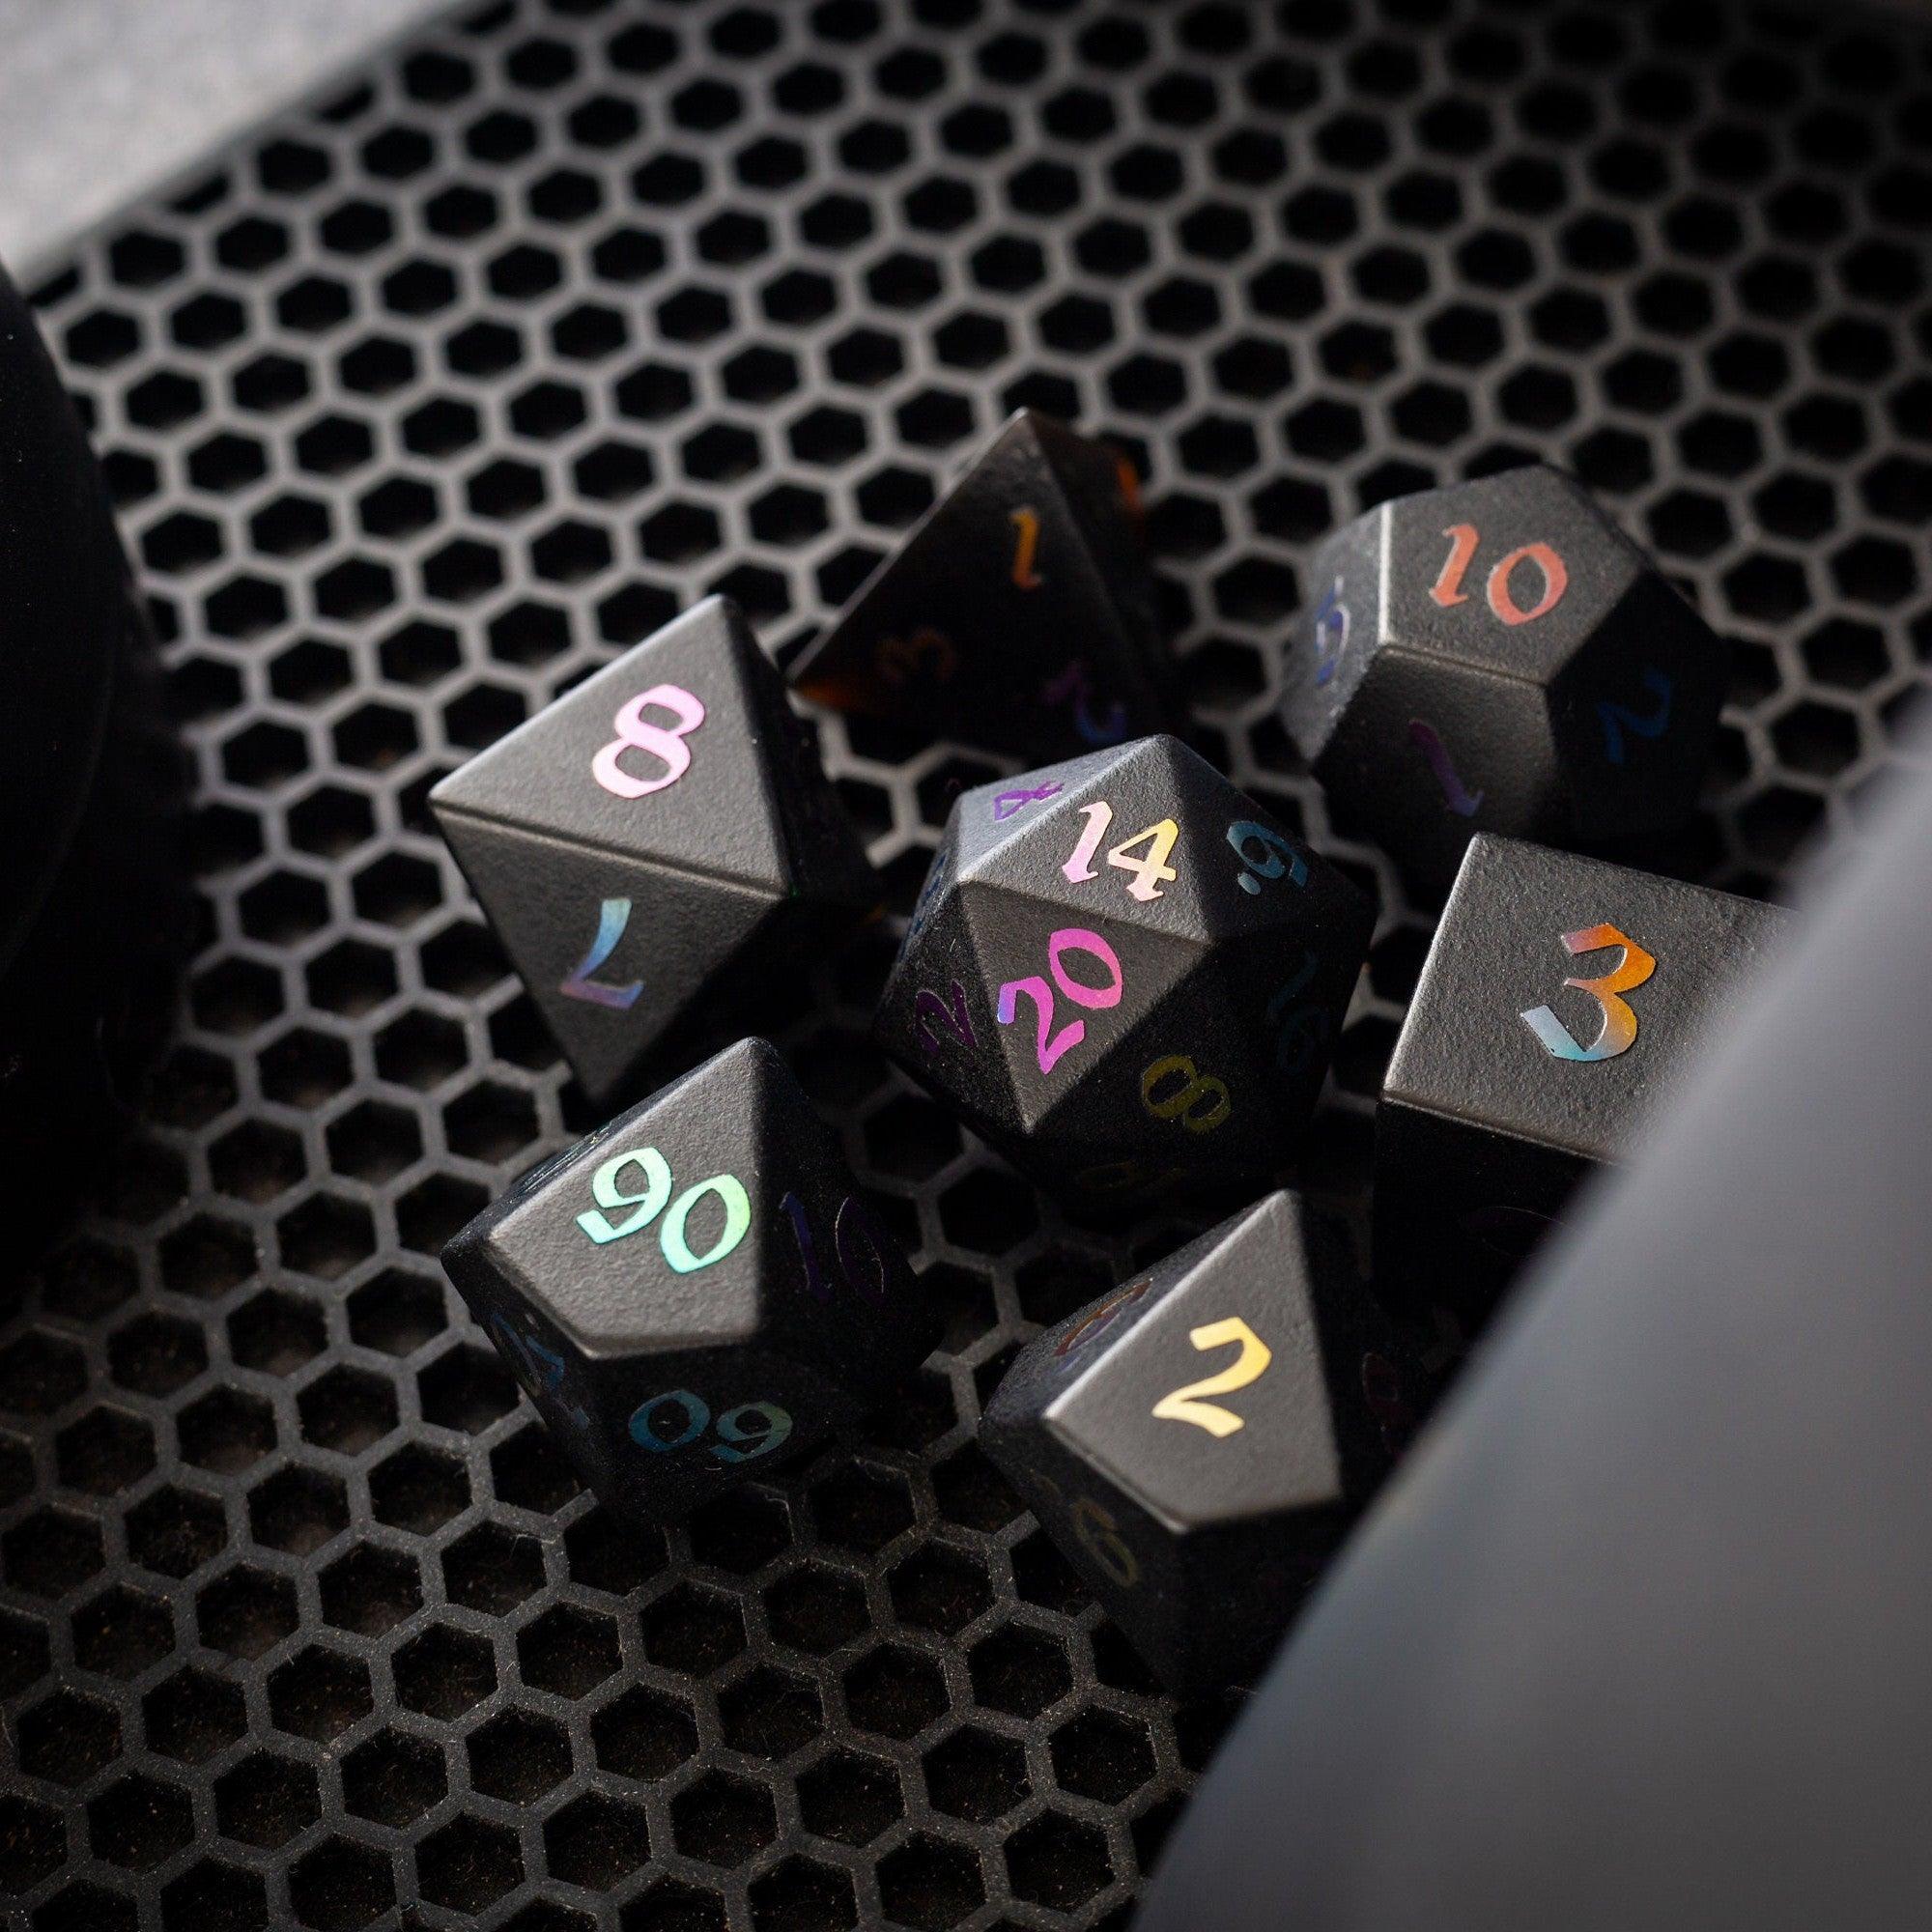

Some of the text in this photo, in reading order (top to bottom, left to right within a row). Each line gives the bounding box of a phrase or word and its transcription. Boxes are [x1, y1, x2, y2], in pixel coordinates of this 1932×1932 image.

[1009, 504, 1047, 593] 1
[1428, 523, 1570, 627] 10
[591, 683, 706, 800] 8
[1407, 718, 1485, 818] 1
[1594, 667, 1676, 766] 2
[993, 781, 1064, 822] 4
[1062, 801, 1180, 902] 14
[559, 896, 645, 1010] 7
[997, 927, 1124, 1074] 20
[1520, 922, 1658, 1063] 3
[1140, 1054, 1232, 1134] 8
[575, 1147, 752, 1274] 90
[1151, 1317, 1272, 1439] 2
